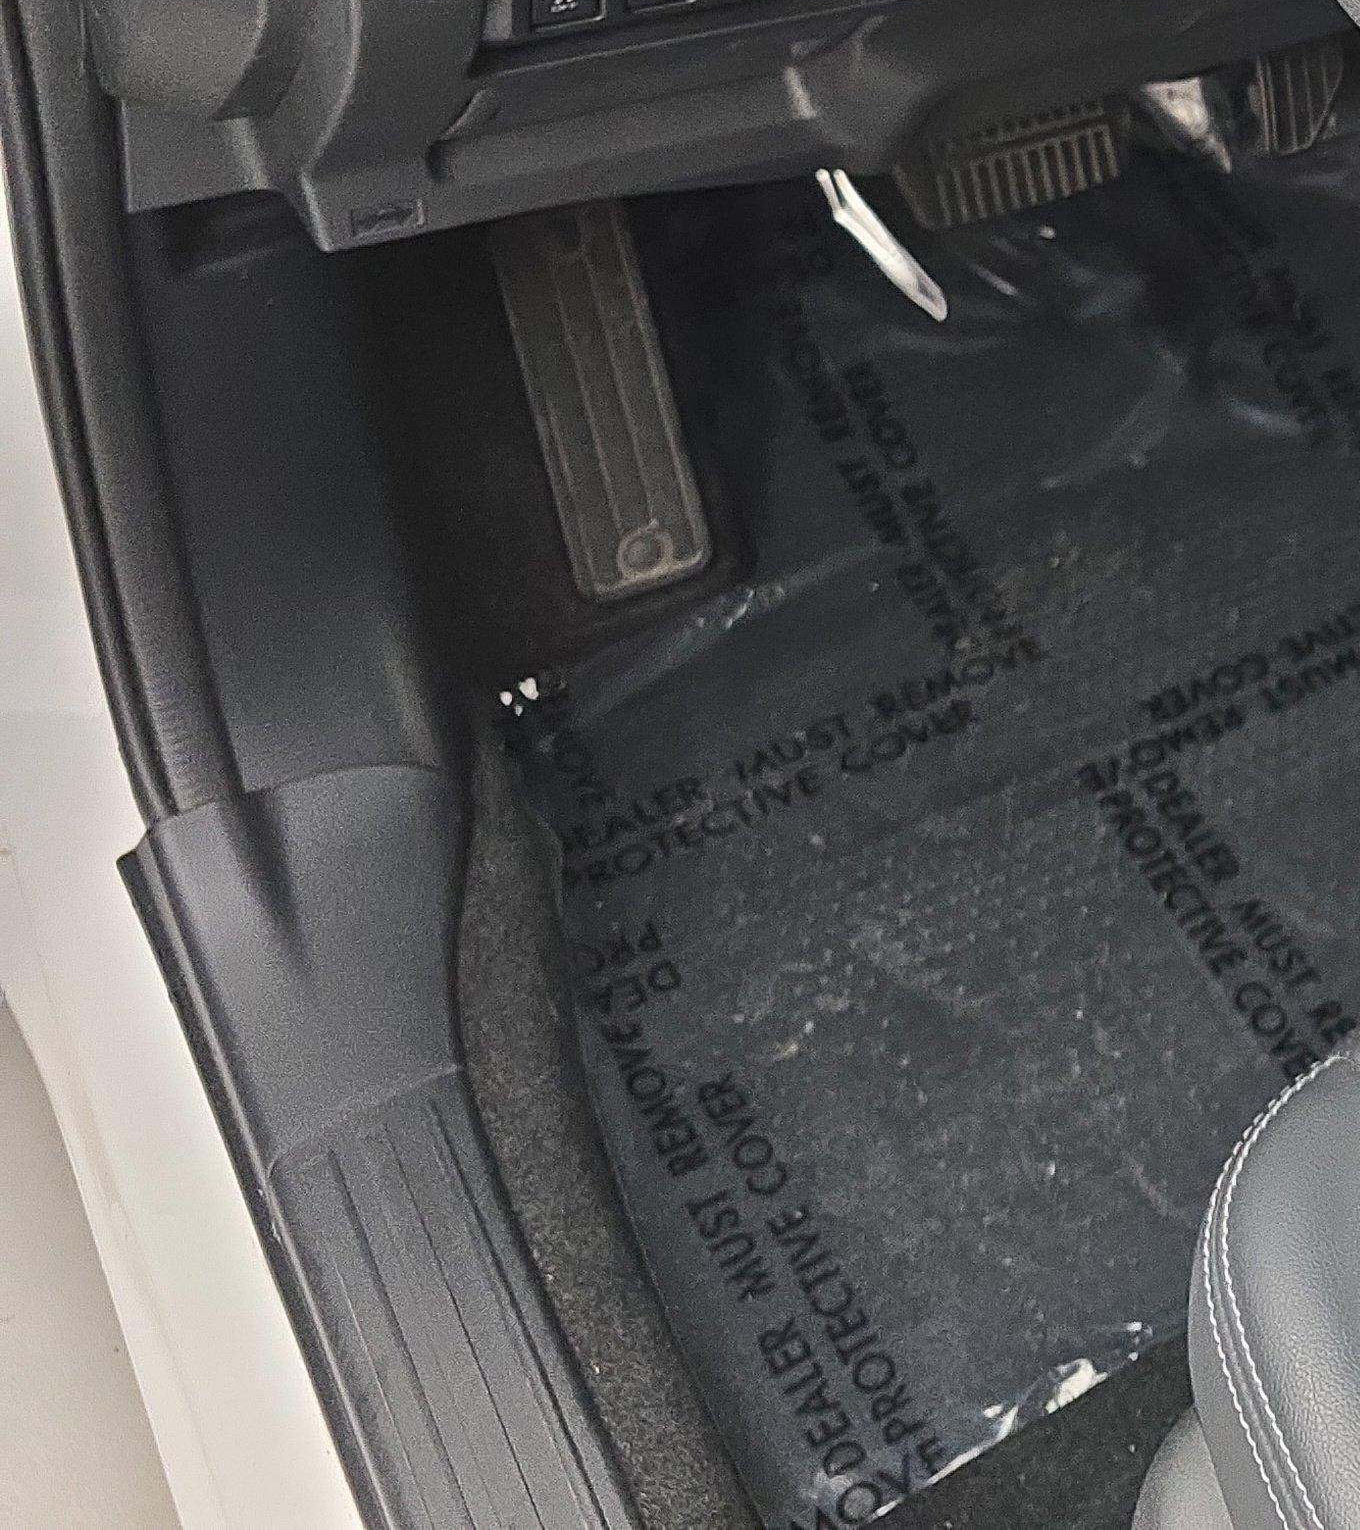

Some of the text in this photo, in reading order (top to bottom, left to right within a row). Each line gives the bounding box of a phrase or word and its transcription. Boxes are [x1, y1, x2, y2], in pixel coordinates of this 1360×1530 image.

[1231, 979, 1321, 1081] COVE
[683, 1186, 779, 1305] MUST
[696, 1069, 926, 1446] PROTECTIVE COVER
[756, 1318, 868, 1477] DEALER
